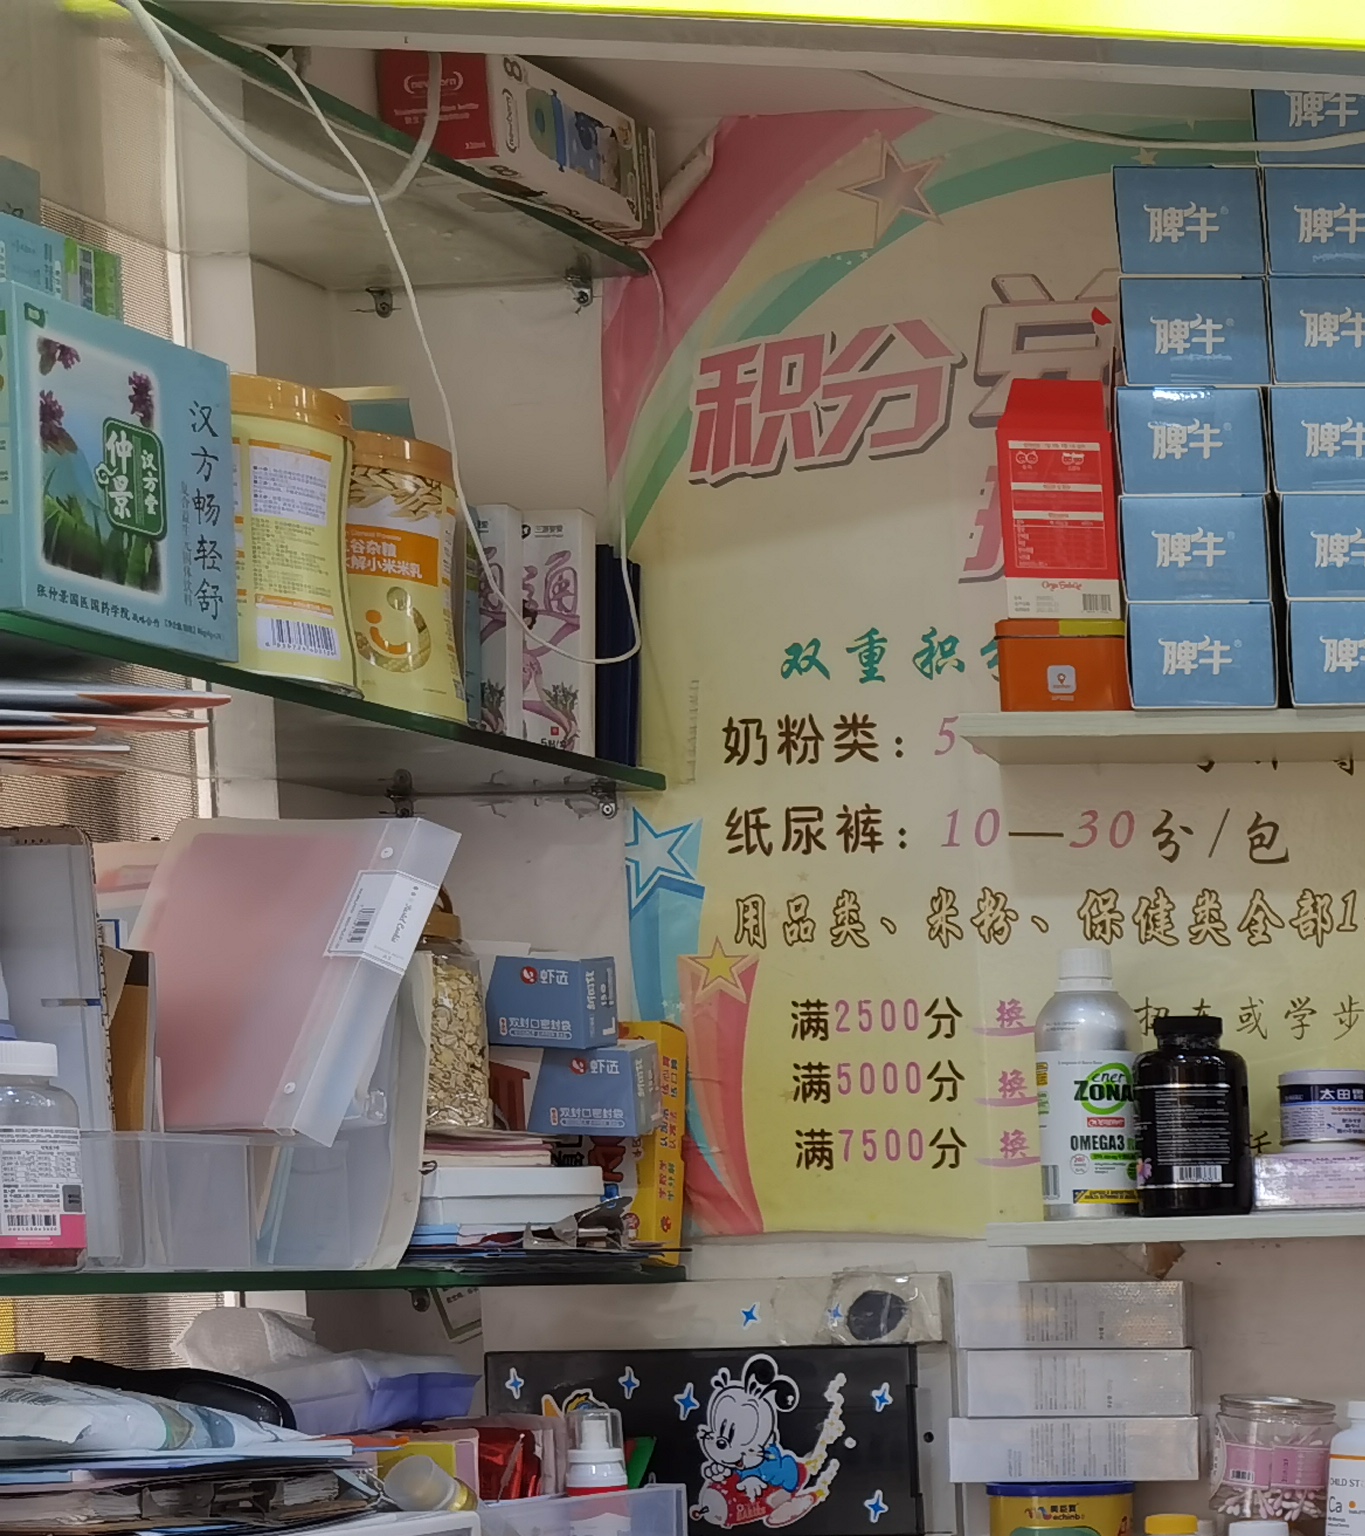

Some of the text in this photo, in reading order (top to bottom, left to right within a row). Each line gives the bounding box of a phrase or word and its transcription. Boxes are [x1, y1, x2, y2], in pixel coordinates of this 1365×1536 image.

[1143, 202, 1219, 244] 脾牛
[1149, 314, 1225, 354] 脾牛
[1148, 418, 1223, 460] 脾牛
[106, 430, 133, 519] 仲景
[189, 401, 224, 621] 汉方畅轻舒
[791, 996, 962, 1041] 满2500分
[793, 1059, 965, 1103] 满5000分
[795, 1126, 967, 1170] 满7500分
